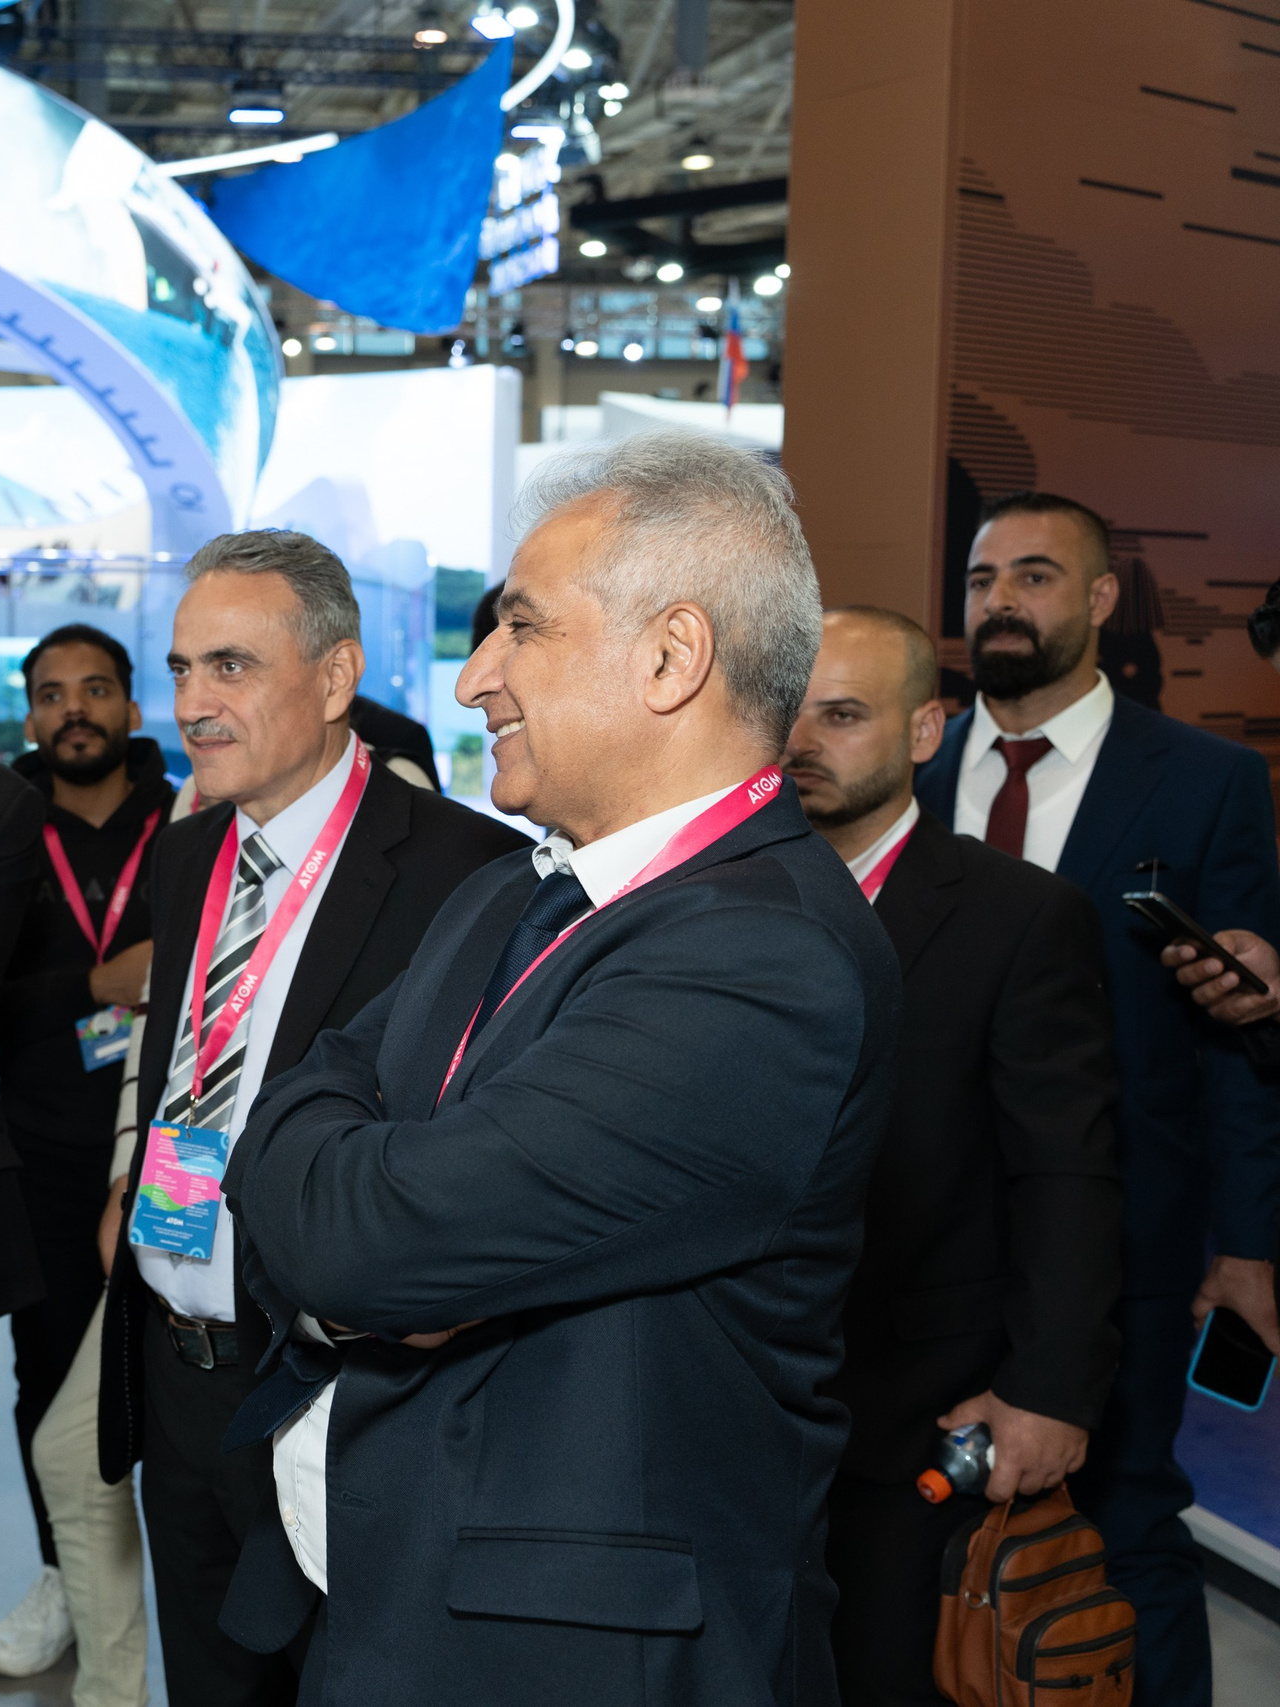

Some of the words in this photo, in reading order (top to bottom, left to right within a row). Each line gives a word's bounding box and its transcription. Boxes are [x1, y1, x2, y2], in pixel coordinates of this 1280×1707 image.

[747, 771, 783, 805] ATOM
[298, 850, 326, 890] ATOM
[230, 974, 258, 1014] ATOM
